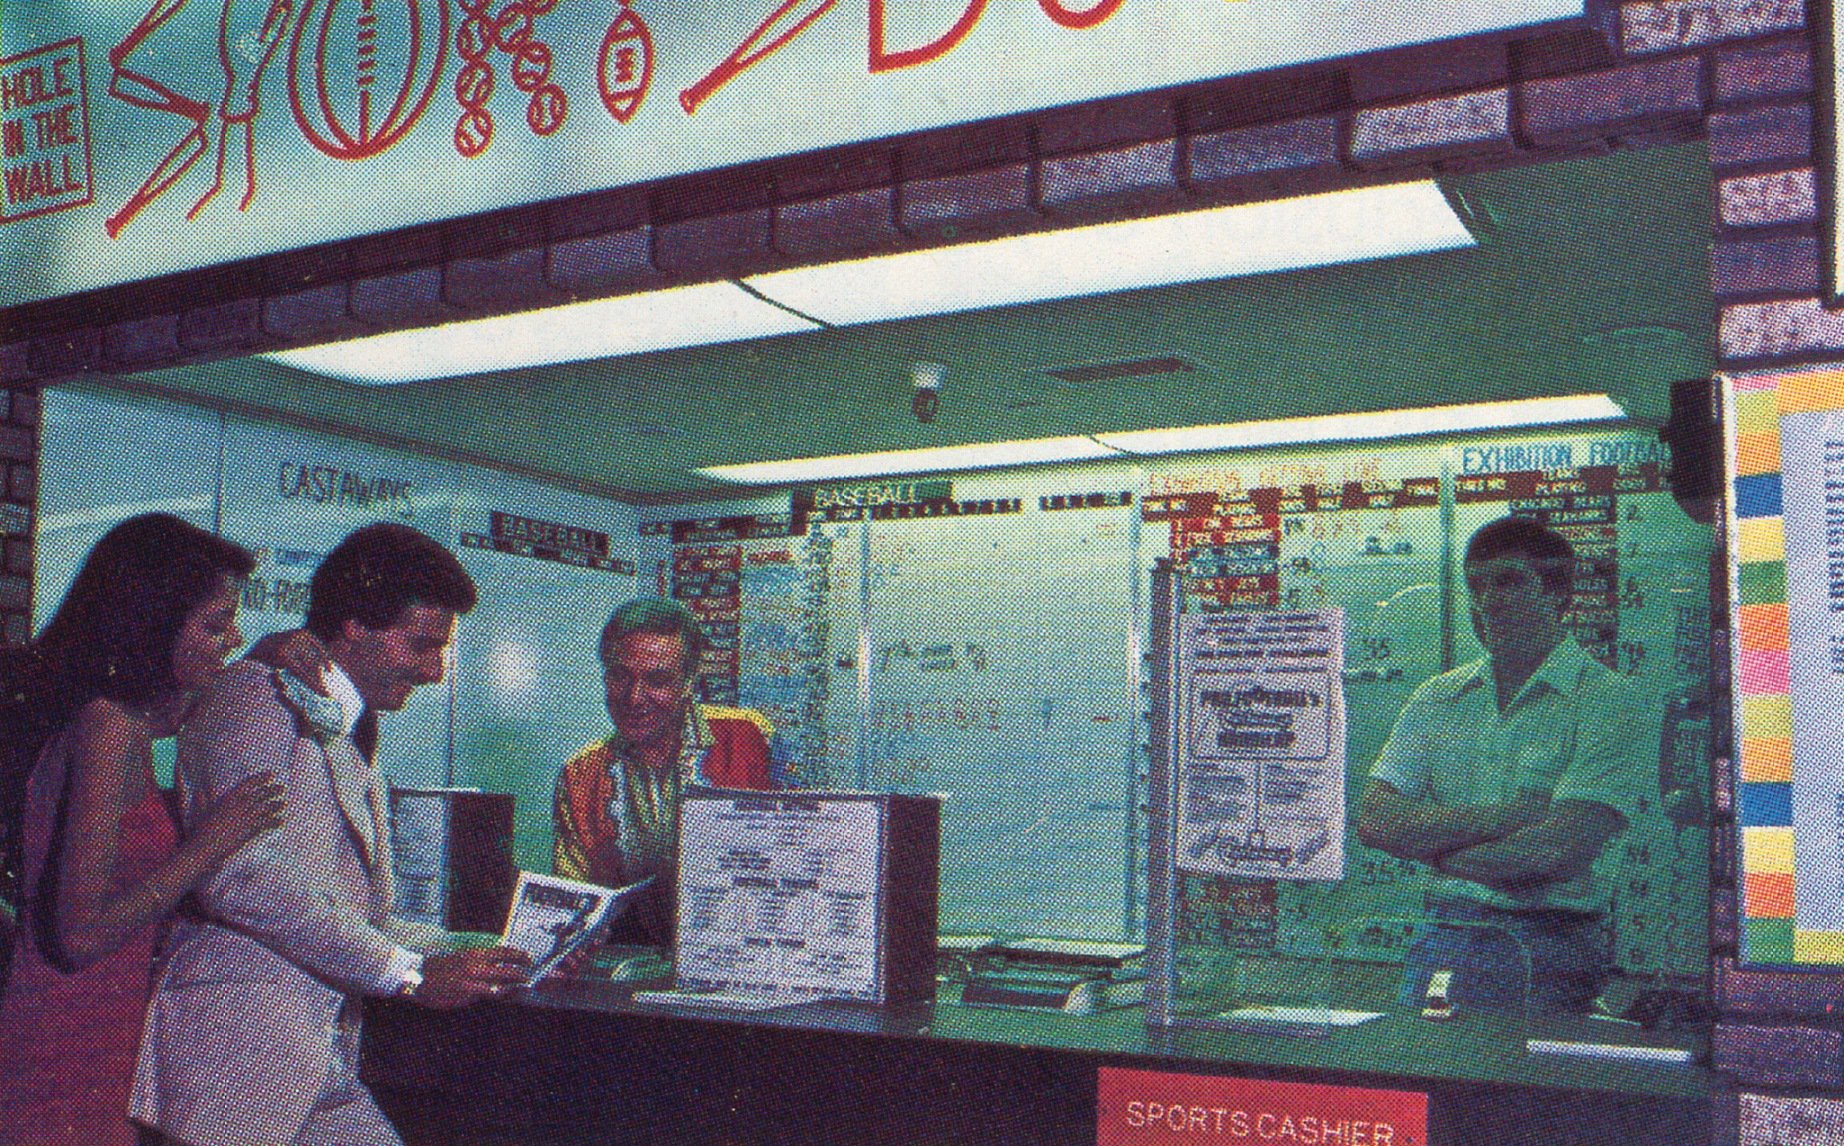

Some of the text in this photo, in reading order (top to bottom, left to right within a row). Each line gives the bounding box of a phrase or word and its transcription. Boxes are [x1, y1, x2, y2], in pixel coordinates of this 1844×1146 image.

[2, 56, 73, 112] HOLE
[3, 103, 77, 158] IN THE
[5, 153, 83, 205] WALL
[1463, 443, 1571, 474] EXHIBITION
[279, 461, 414, 518] CASTAWAYS
[815, 482, 922, 508] BASEBALL
[502, 515, 598, 549] BASEBALL
[1126, 1100, 1394, 1146] SPORTS CASHIER
